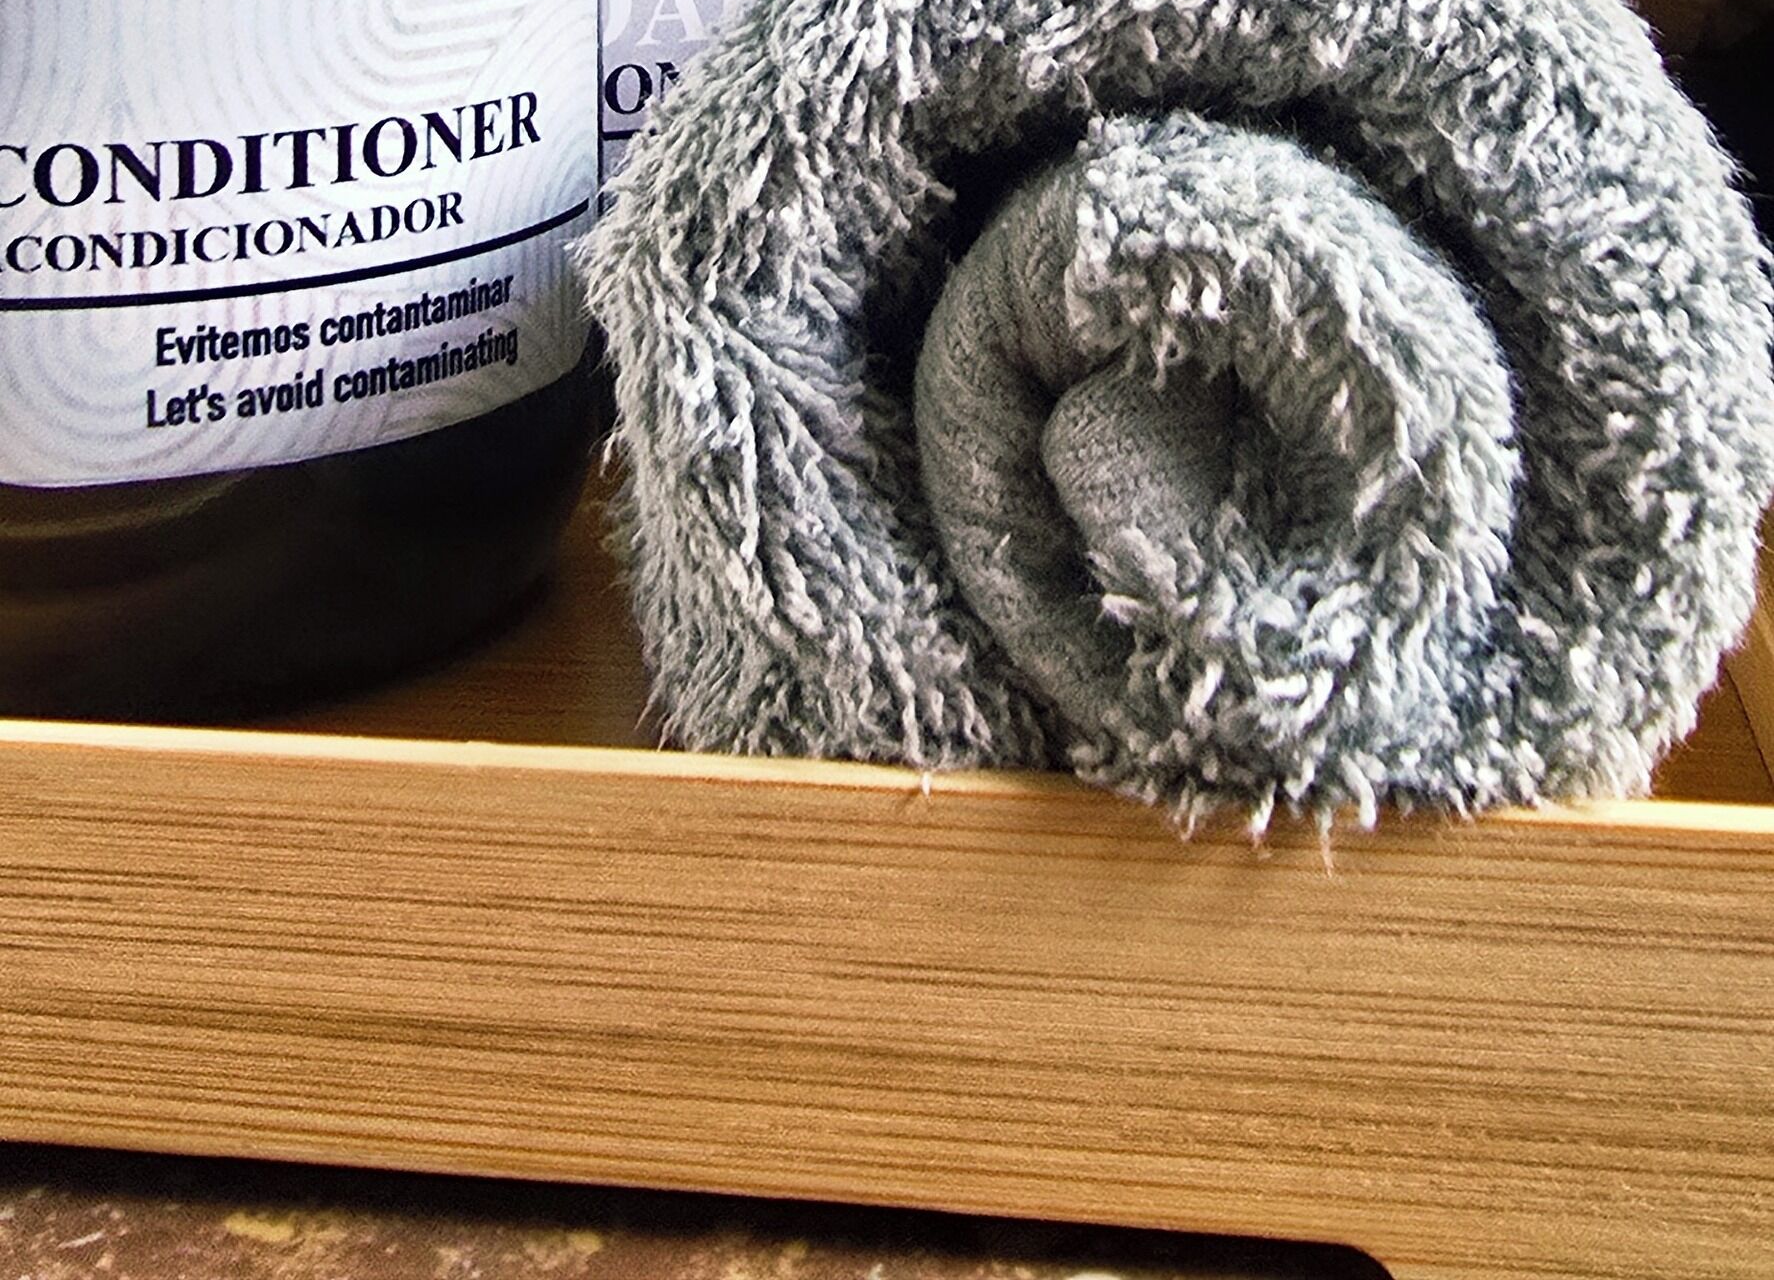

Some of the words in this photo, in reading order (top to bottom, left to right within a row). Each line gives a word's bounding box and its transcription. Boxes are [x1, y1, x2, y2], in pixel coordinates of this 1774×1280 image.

[0, 191, 465, 274] CONDICIONADOR
[156, 322, 310, 367] Evitemos
[320, 275, 514, 347] contantaminar
[147, 385, 226, 428] Let's
[237, 369, 323, 418] avoid
[333, 326, 519, 403] contaminating
